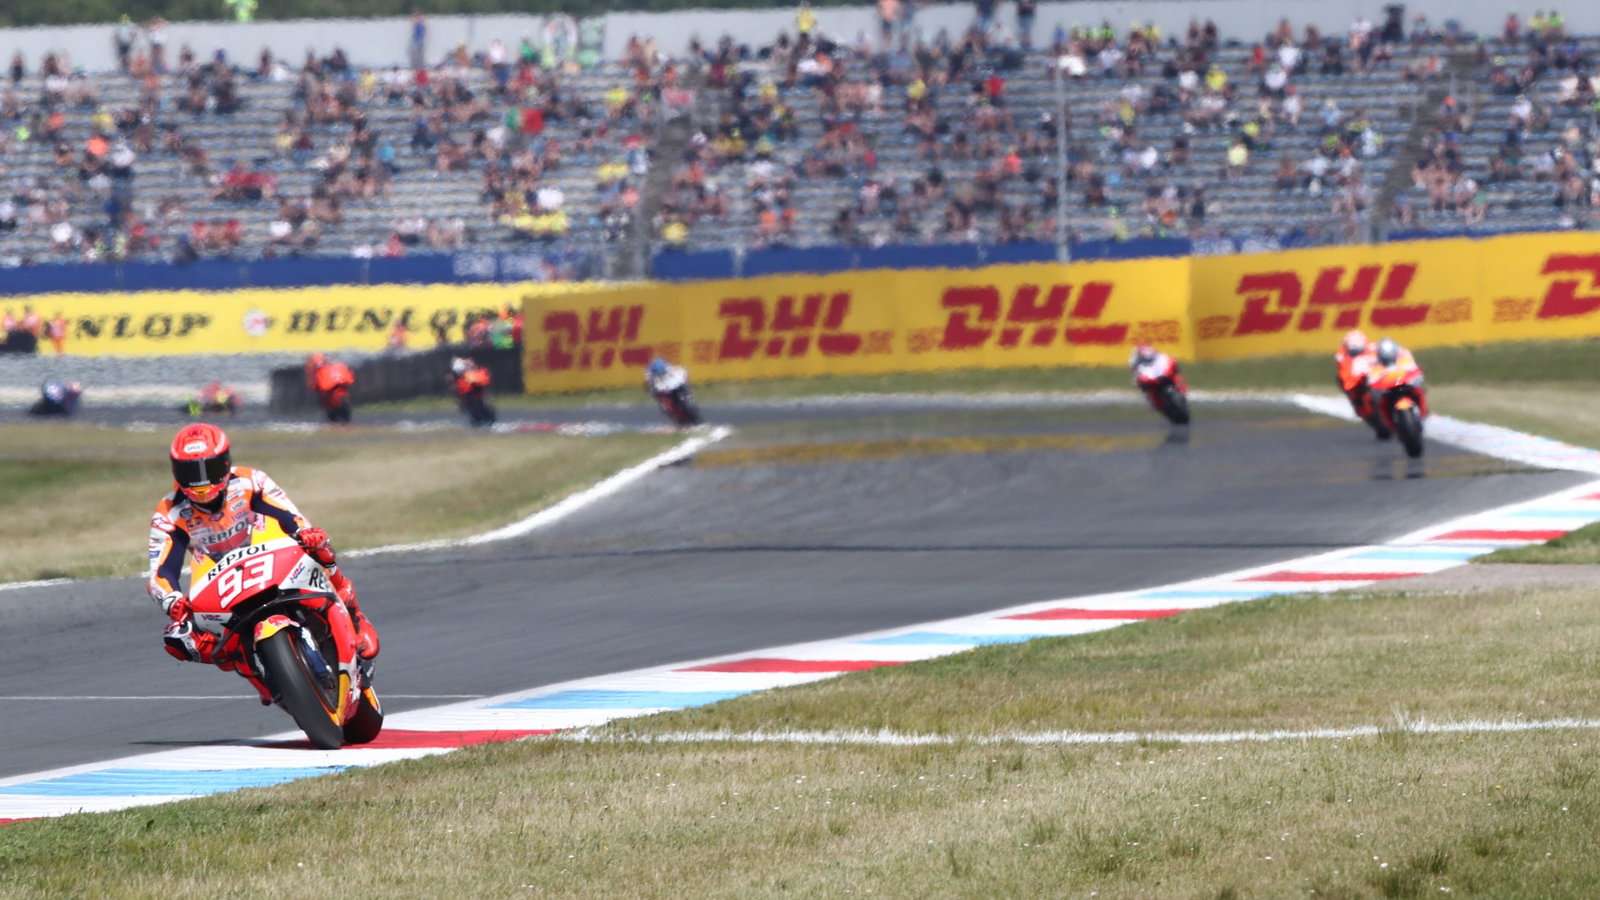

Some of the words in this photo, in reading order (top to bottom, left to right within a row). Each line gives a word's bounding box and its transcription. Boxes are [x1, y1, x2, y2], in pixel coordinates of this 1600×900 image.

[75, 313, 213, 340] NLOP
[717, 292, 862, 361] DHL
[939, 281, 1130, 351] DHL
[1233, 262, 1430, 337] DHL
[543, 304, 654, 372] DHL
[199, 517, 250, 545] REPSOL
[208, 544, 269, 581] REPSOL
[217, 553, 275, 609] 93
